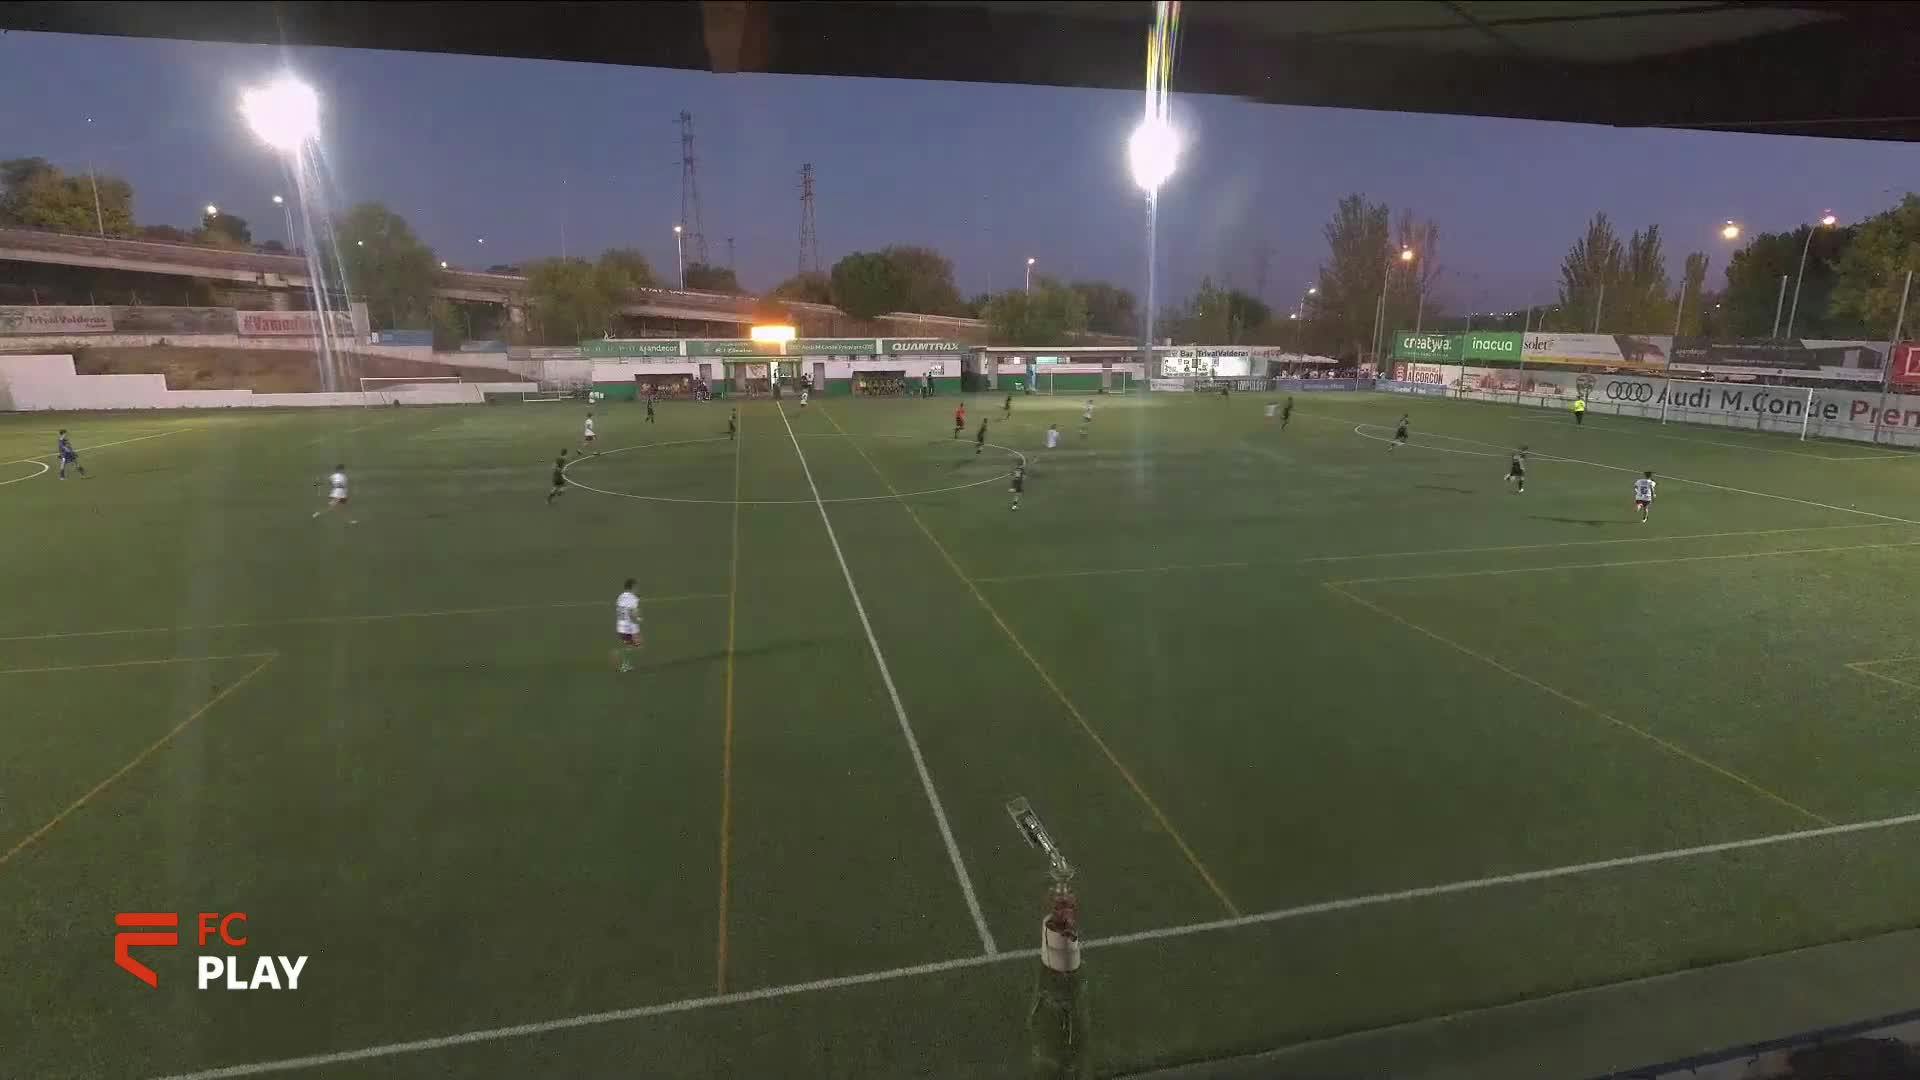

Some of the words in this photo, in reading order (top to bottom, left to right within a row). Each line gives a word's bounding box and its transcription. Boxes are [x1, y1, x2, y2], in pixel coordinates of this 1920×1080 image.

[892, 343, 959, 351] QUAMTRAX
[1472, 336, 1513, 351] inacua
[1656, 387, 1712, 408] Audi
